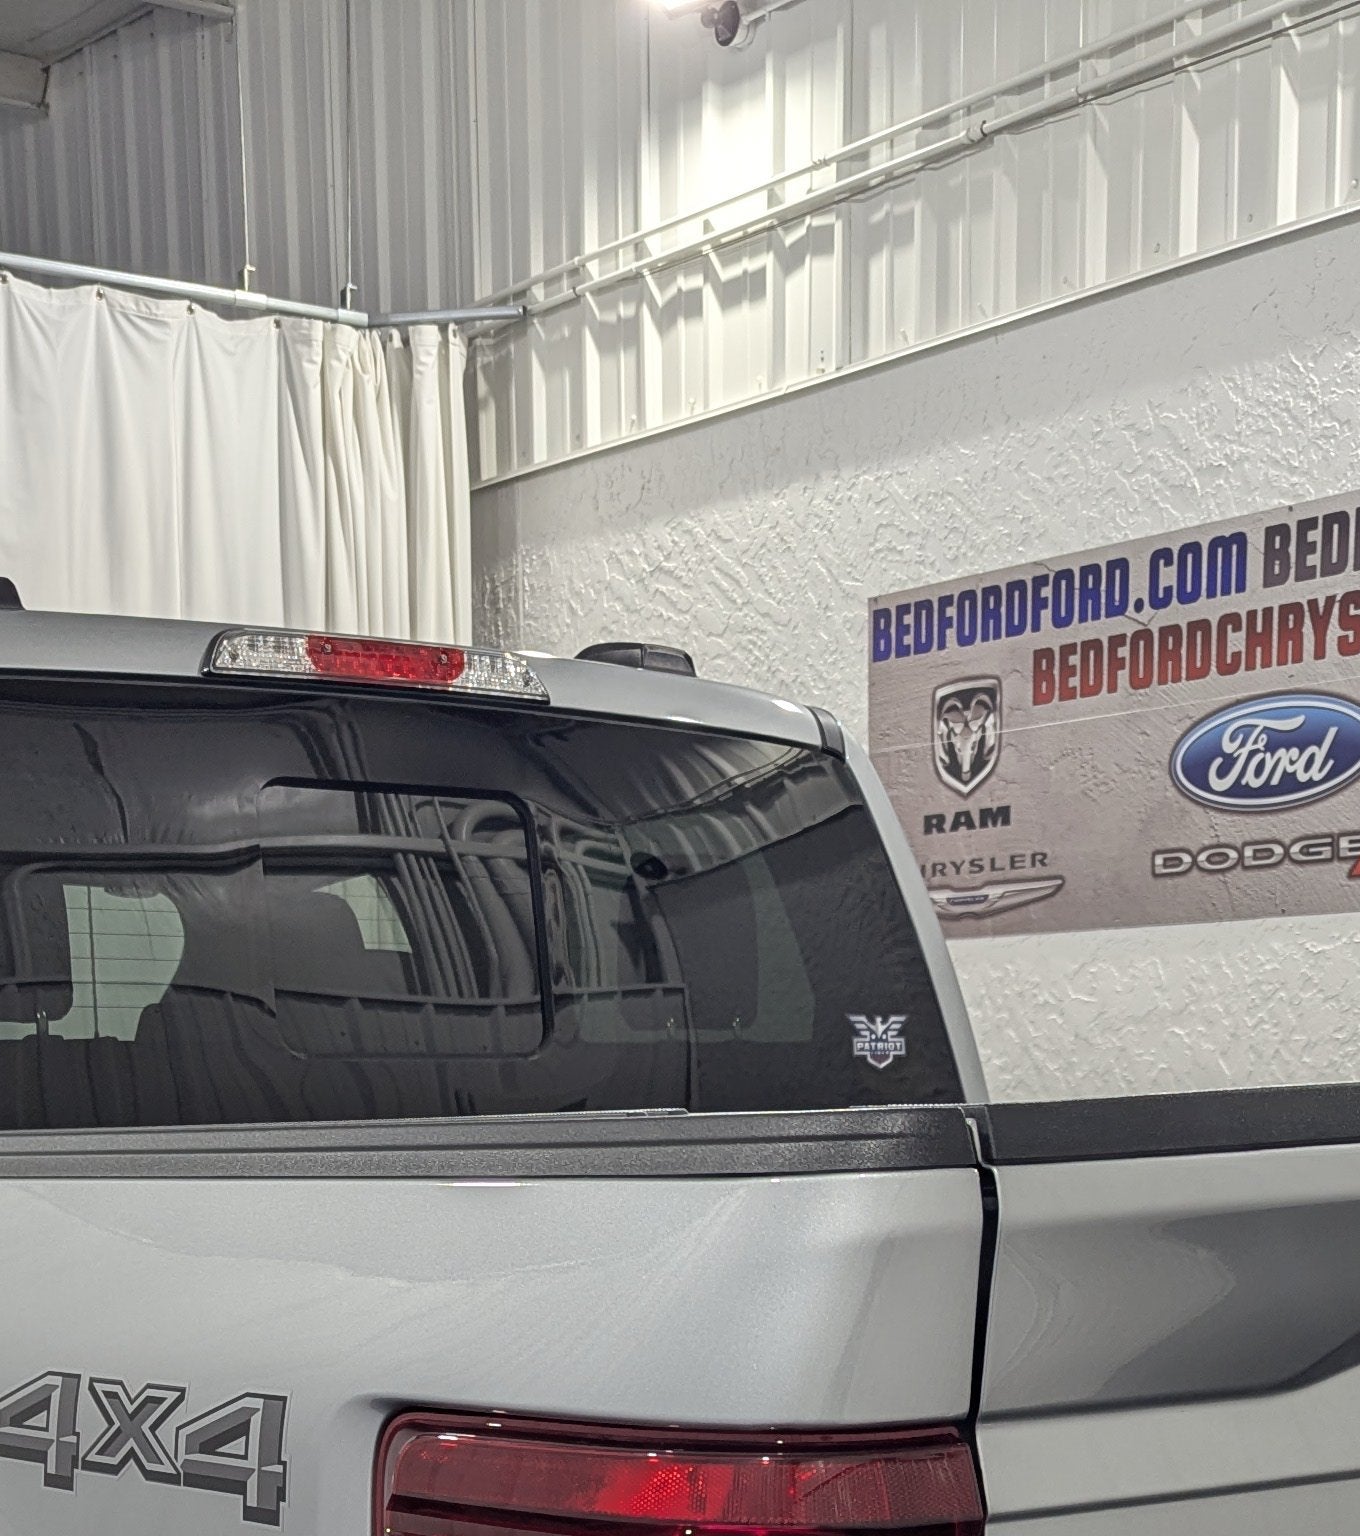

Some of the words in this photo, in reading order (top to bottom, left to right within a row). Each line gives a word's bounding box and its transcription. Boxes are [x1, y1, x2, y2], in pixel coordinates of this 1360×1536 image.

[872, 531, 1248, 663] BEDFORDFORD.COM
[1208, 714, 1339, 792] Ford
[923, 805, 1012, 836] RAM
[920, 852, 1049, 879] RYSLER
[856, 1042, 903, 1051] PATRIOT
